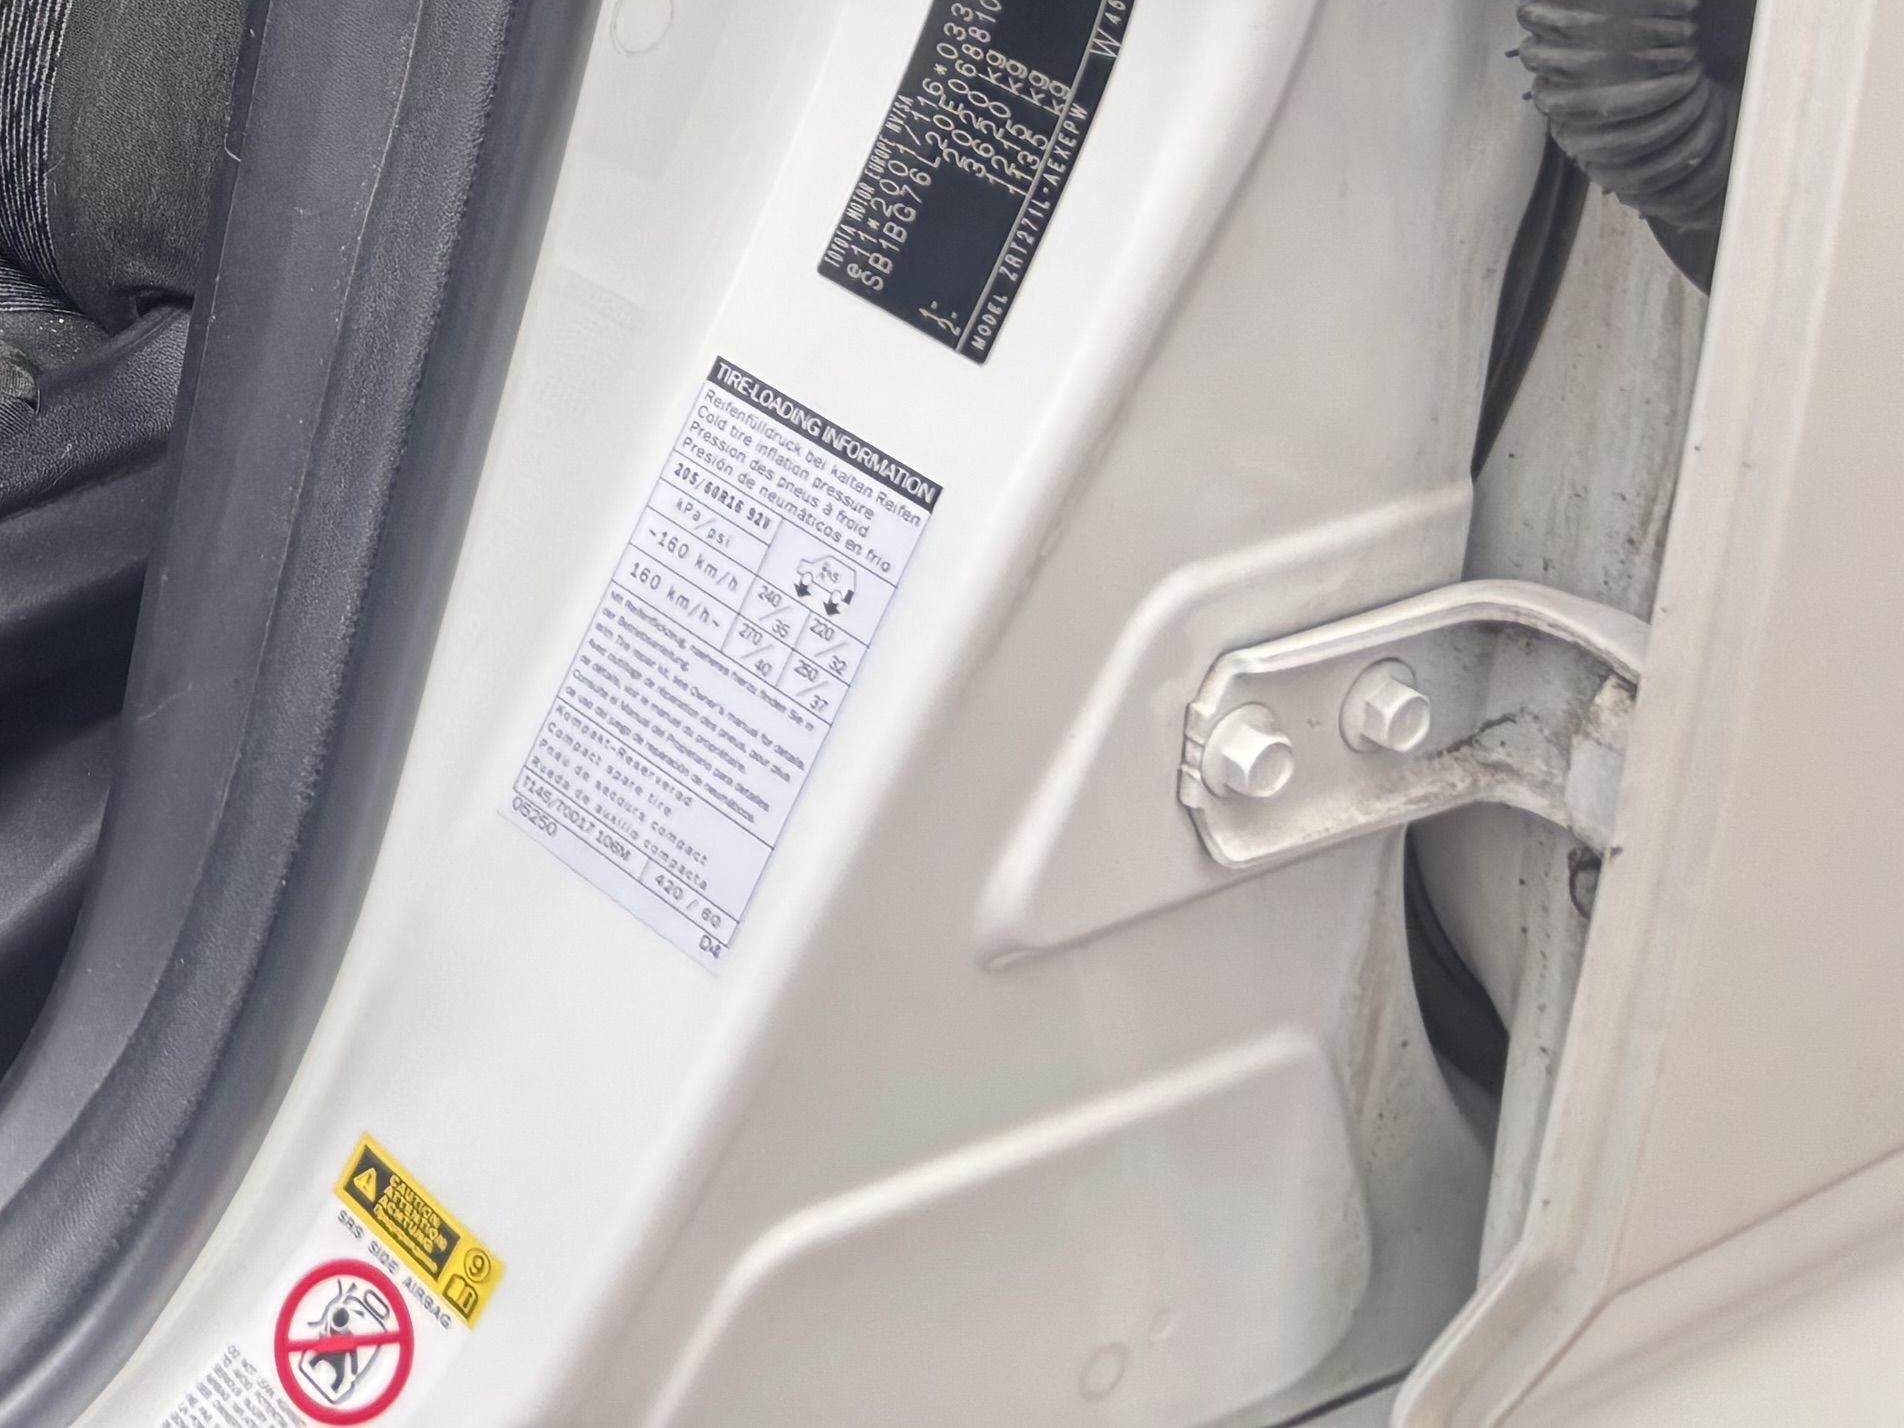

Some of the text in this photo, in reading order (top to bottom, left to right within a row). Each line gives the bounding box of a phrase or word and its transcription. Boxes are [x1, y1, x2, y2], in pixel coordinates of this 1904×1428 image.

[941, 47, 1008, 169] 2020 kg
[961, 57, 1030, 180] 3620 kg
[981, 116, 1030, 190] 1215
[1020, 68, 1051, 105] kg
[1003, 127, 1050, 200] 1135
[823, 92, 914, 270] TOYOTA MOTOR EUROPE NV/SA
[970, 288, 1008, 353] MODEL
[688, 419, 748, 464] Pression
[748, 456, 777, 481] des
[776, 475, 820, 510] pneus
[834, 508, 871, 539] froid
[695, 403, 875, 523] Cold tire inflation pressure
[702, 387, 804, 457] Reifenfülldruck
[803, 448, 828, 471] bei
[874, 490, 922, 528] Reifen
[713, 361, 937, 505] TIRE-LOADING INFORMATION
[680, 434, 735, 477] Presión
[736, 469, 757, 490] de
[843, 537, 863, 556] en
[629, 560, 662, 592] 160
[692, 553, 741, 595] km/h
[381, 1184, 450, 1253] ATTENTION
[387, 1173, 443, 1230] CAUTION
[335, 1209, 365, 1240] SRS
[365, 1238, 400, 1275] SIDE
[399, 1273, 455, 1330] AIRBAG
